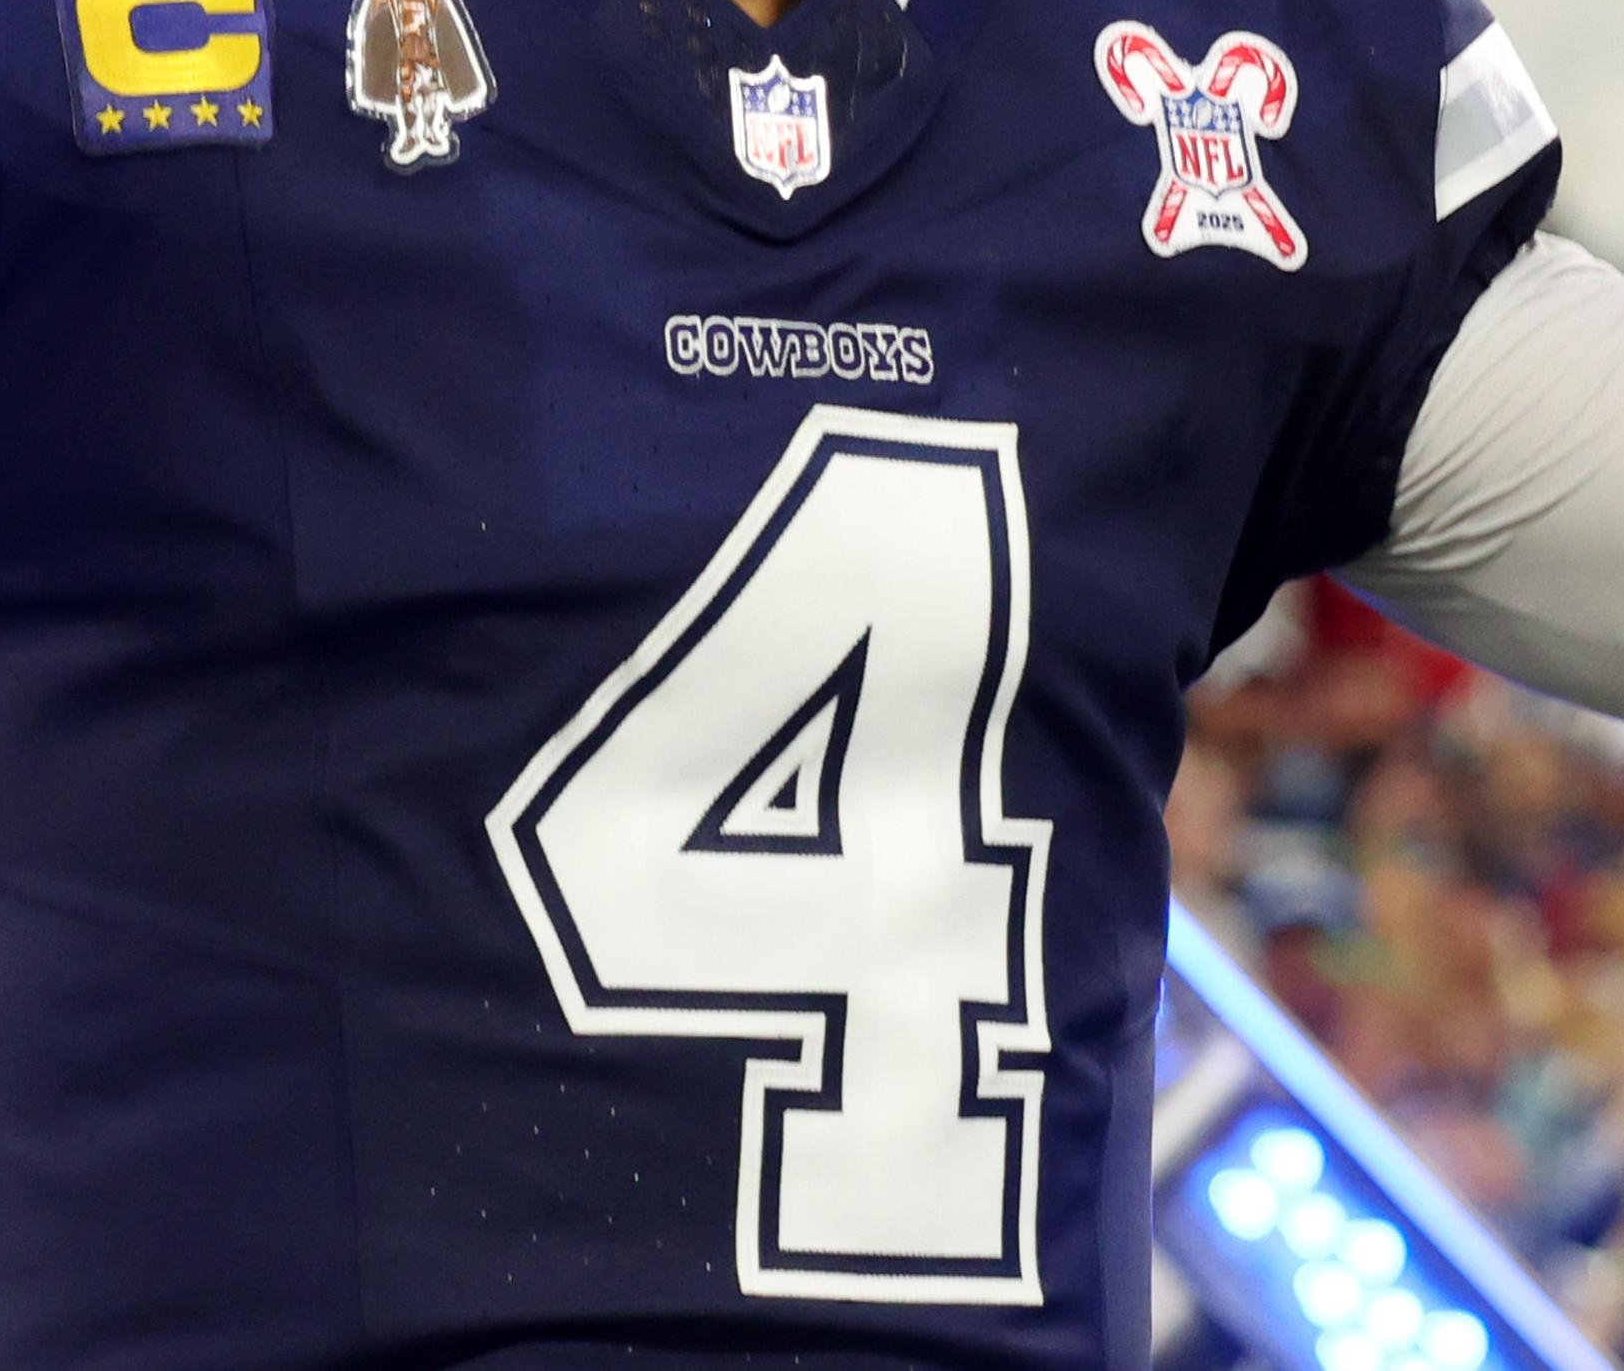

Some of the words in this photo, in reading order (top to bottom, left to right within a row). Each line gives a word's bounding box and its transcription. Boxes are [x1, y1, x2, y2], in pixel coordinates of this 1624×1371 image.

[748, 117, 816, 170] NFL
[1176, 132, 1244, 186] NFL
[1196, 210, 1245, 232] 2025
[665, 315, 934, 384] COWBOYS
[484, 403, 1054, 1307] 4
